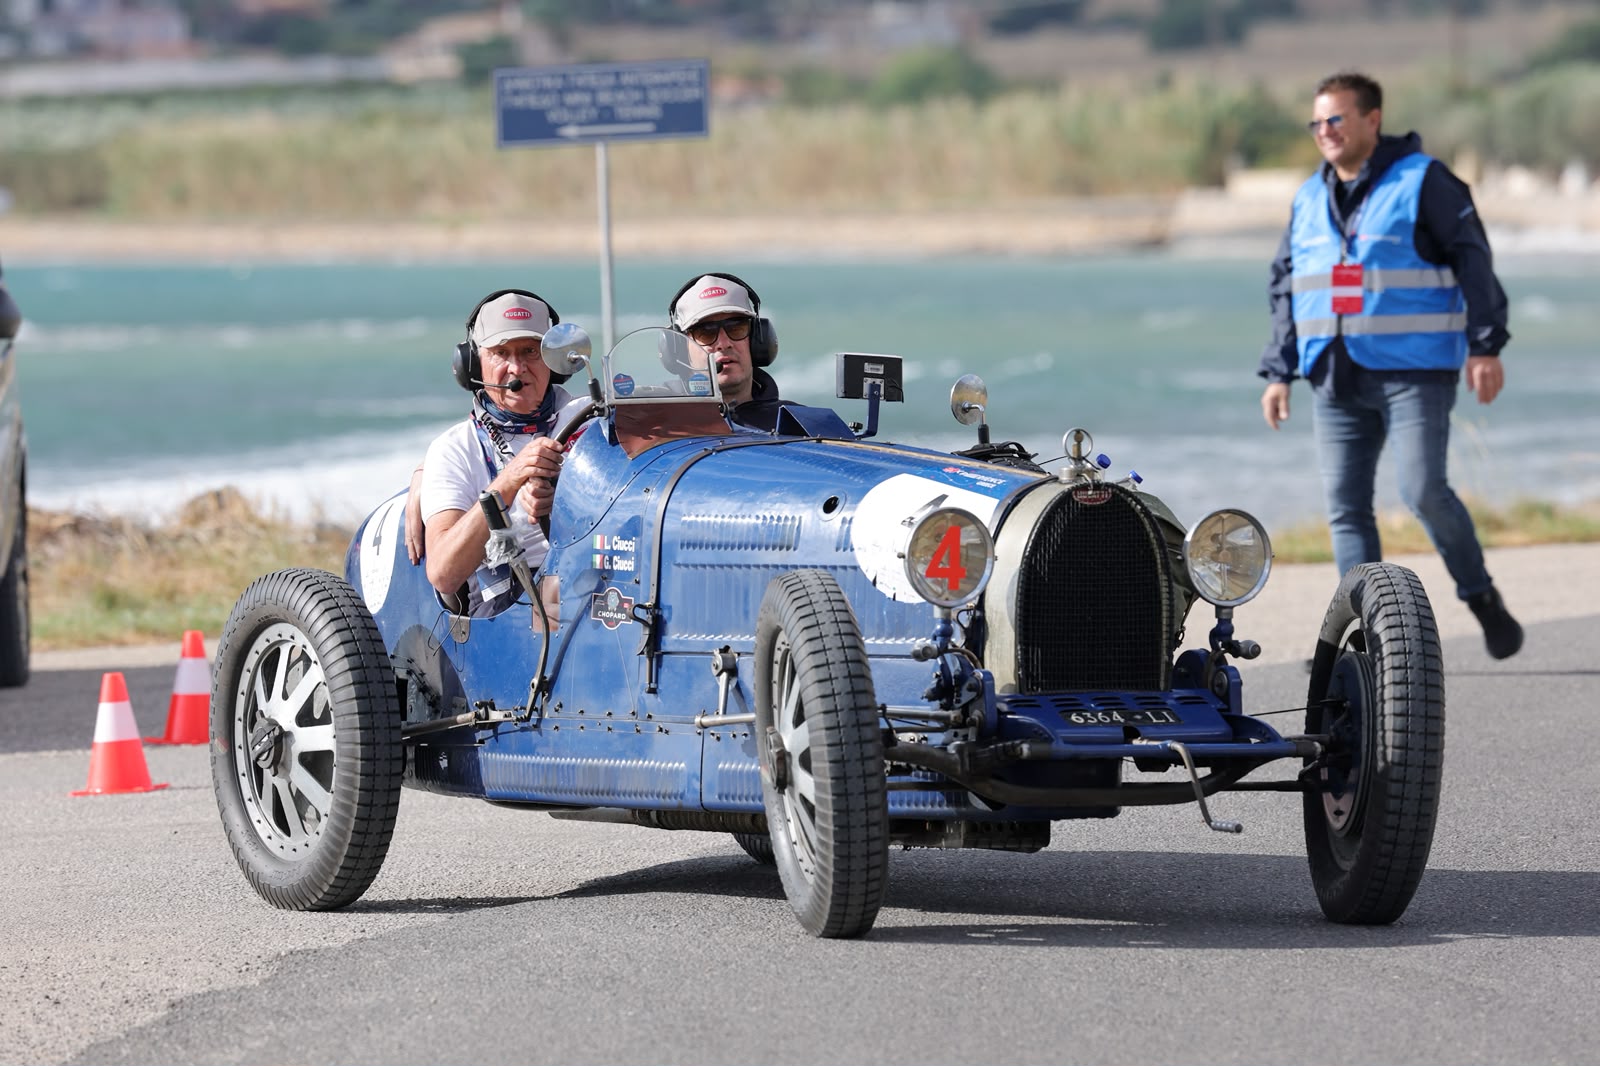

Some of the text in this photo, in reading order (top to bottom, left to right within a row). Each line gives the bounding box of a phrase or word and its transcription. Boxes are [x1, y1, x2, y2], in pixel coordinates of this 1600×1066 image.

[700, 289, 725, 298] BUGATTI
[372, 503, 394, 556] 4
[604, 535, 635, 553] L. Ciucci
[604, 555, 635, 571] G. Ciucci
[925, 525, 967, 591] 4
[597, 610, 626, 620] CHOPARD
[1070, 711, 1176, 723] 6364 LI
